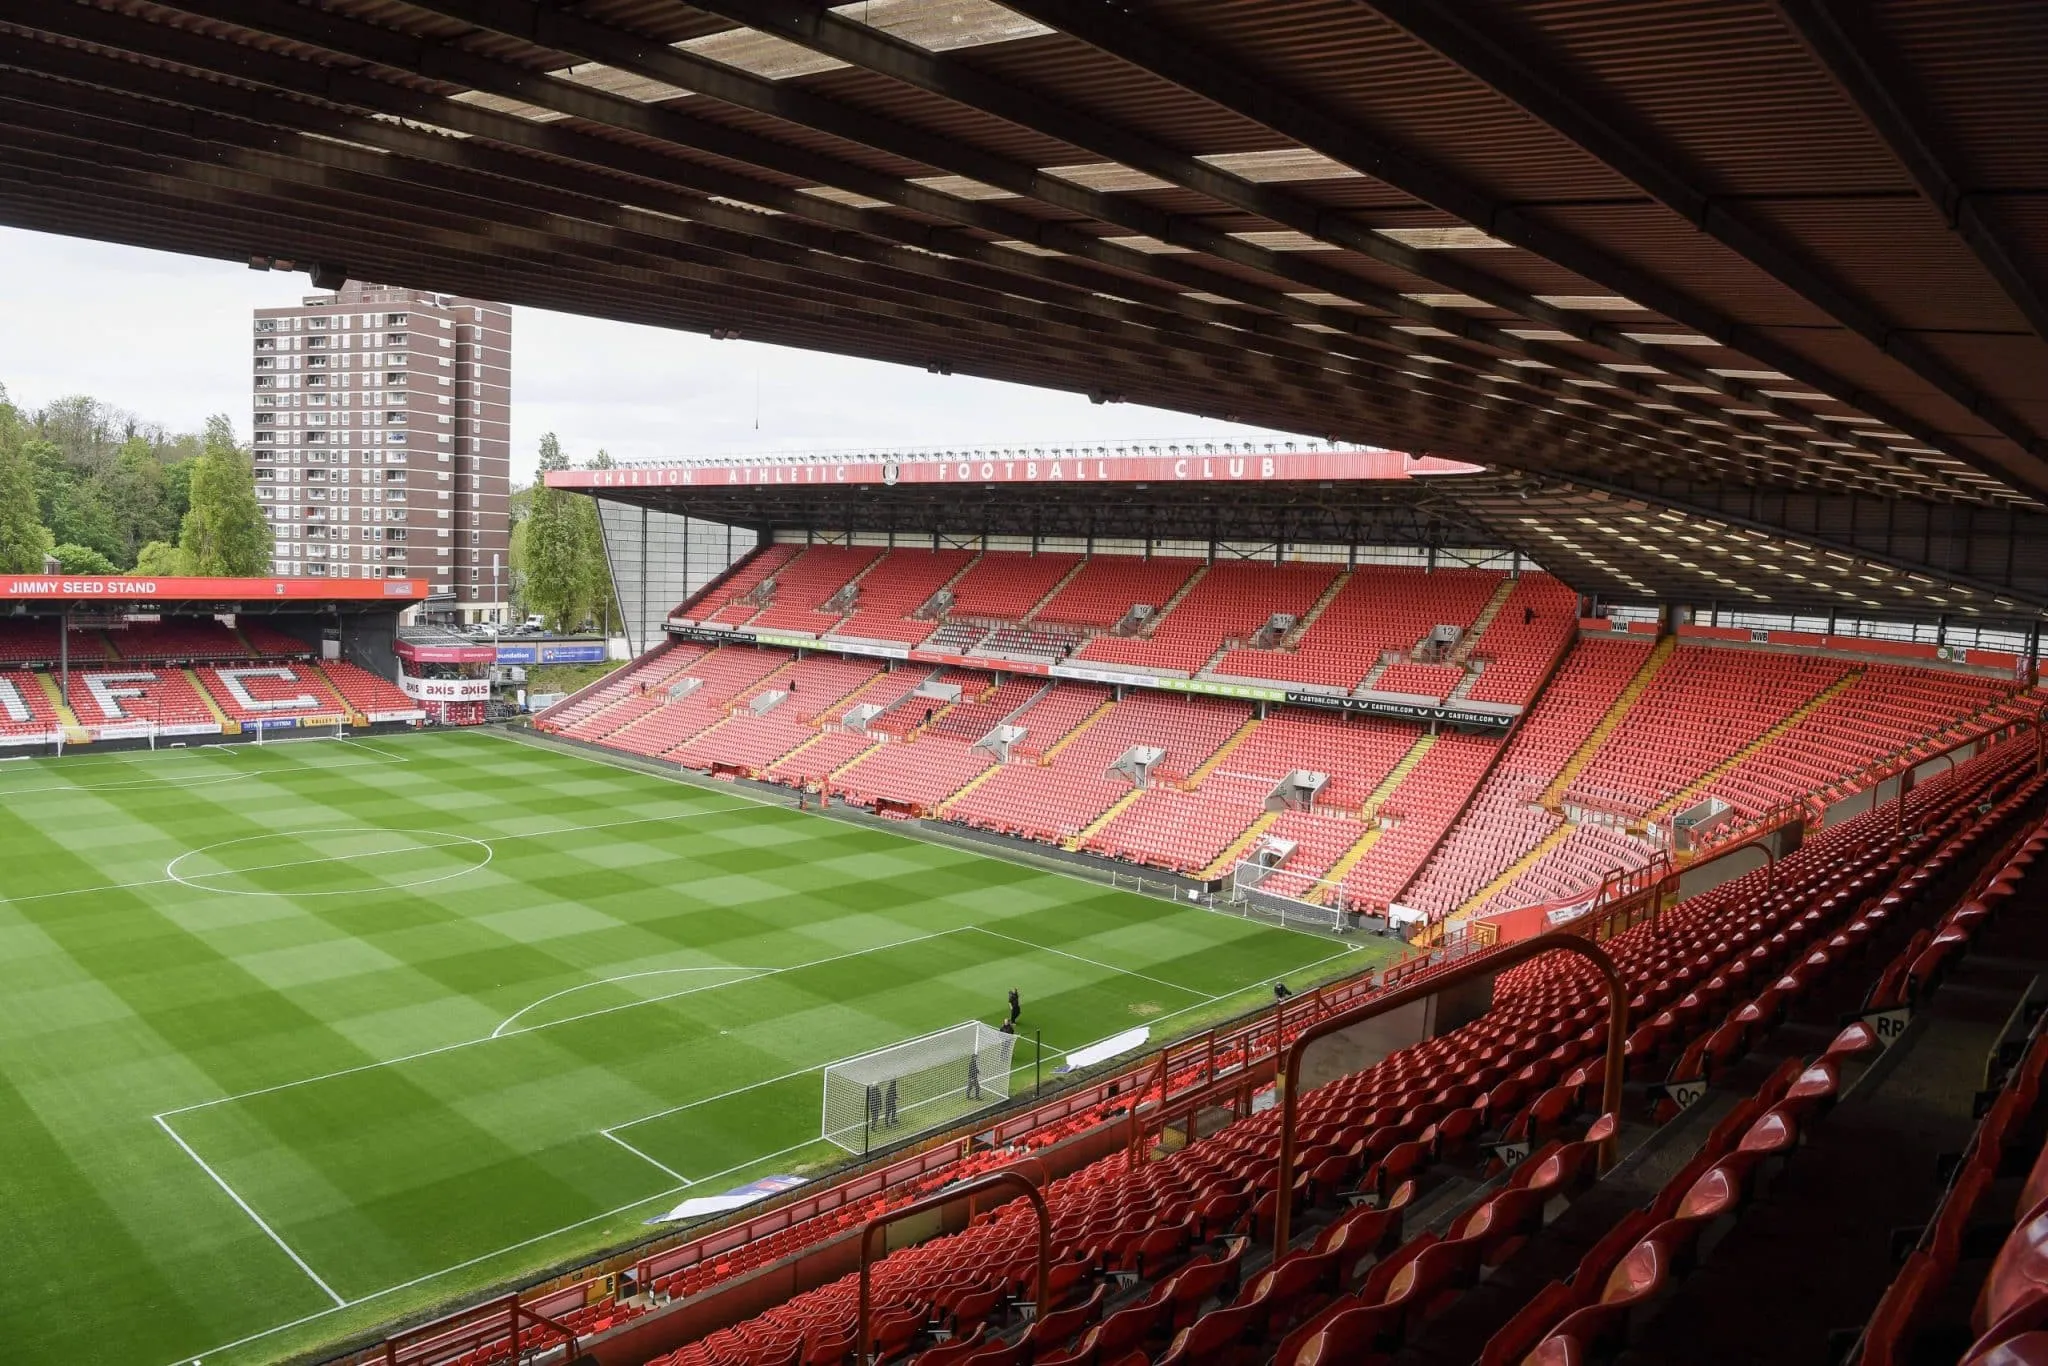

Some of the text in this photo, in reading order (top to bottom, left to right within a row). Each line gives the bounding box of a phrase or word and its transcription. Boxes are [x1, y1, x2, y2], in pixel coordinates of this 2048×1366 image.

[593, 458, 1275, 485] CHARLTON ATHLETIC FOOTBALL CLUB
[9, 581, 156, 593] JIMMY SEED STAND
[1443, 626, 1454, 636] 12
[1751, 631, 1768, 642] NWB
[497, 652, 530, 660] oundation
[426, 685, 455, 695] axis
[460, 684, 488, 695] axis
[1371, 703, 1414, 714] CASTORE.COM
[1448, 712, 1494, 723] CASTORE.COM
[1308, 773, 1315, 783] 6
